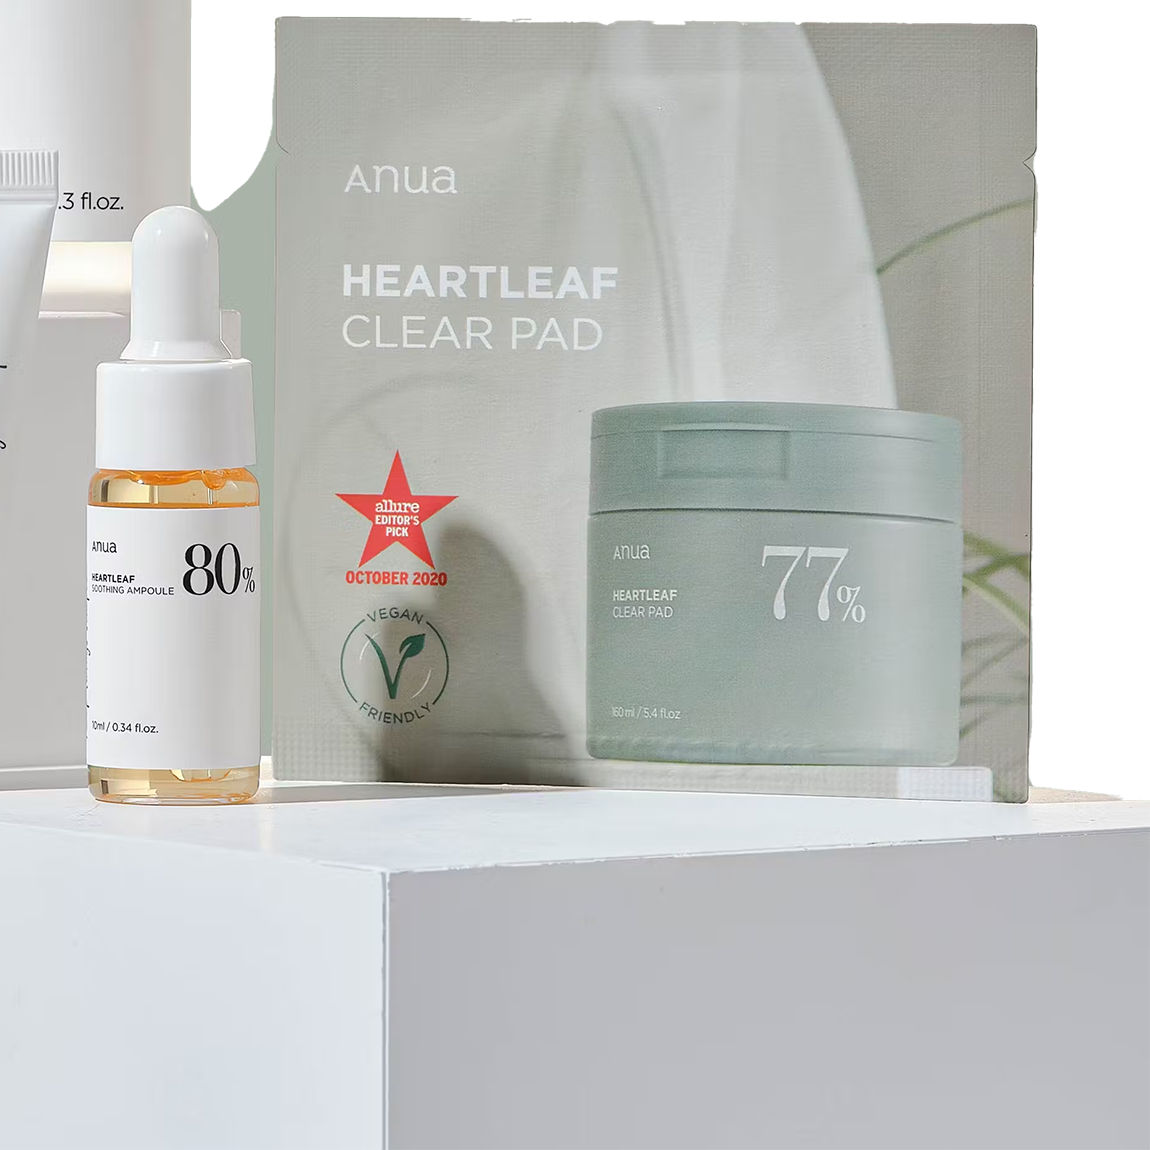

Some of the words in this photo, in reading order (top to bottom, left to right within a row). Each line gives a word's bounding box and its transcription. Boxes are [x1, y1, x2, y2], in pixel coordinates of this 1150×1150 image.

[344, 164, 457, 194] Anua
[59, 193, 74, 209] .3
[342, 263, 618, 300] HEARTLEAF
[342, 314, 493, 350] CLEAR
[511, 316, 603, 351] PAD
[375, 499, 420, 513] allure
[375, 515, 420, 526] EDITOR'S
[386, 527, 409, 537] PICK
[92, 541, 117, 553] Anua
[613, 544, 650, 560] Anua
[183, 543, 255, 595] 80%
[92, 573, 135, 583] HEARTLEAF
[345, 570, 409, 585] OCTOBER
[412, 571, 448, 587] 2020
[762, 545, 866, 623] 77%
[92, 585, 124, 594] SOOTHING
[127, 587, 174, 595] AMPOULE
[612, 589, 678, 602] HEARTLEAF
[367, 607, 424, 625] VEGAN
[612, 605, 645, 618] CLEAR
[648, 606, 674, 619] PAD
[359, 701, 431, 724] FRIENDLY
[112, 722, 132, 733] 0.34
